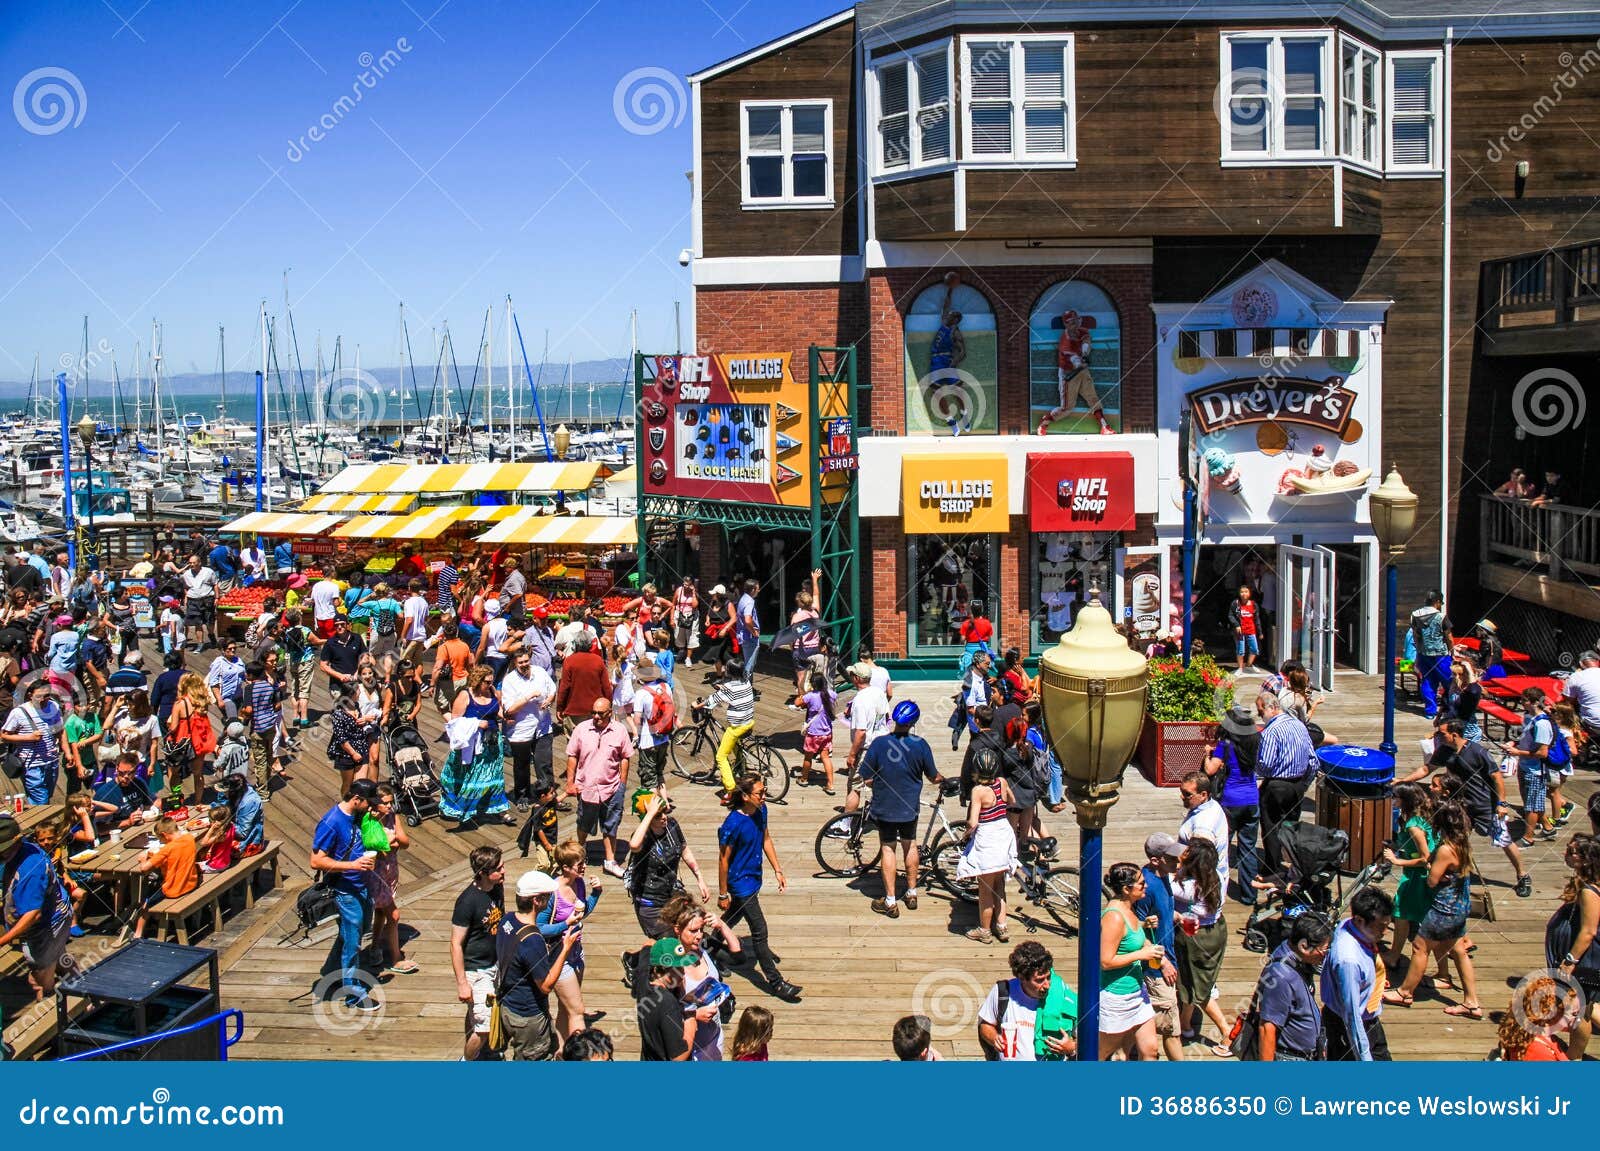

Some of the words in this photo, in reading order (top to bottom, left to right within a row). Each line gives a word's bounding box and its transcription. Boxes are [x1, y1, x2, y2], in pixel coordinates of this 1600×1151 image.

[680, 357, 712, 382] NFL
[729, 358, 783, 380] COLLEGE
[680, 383, 710, 403] Shop
[1201, 384, 1344, 425] Dreyer's
[829, 457, 855, 470] SHOP
[920, 479, 993, 499] COLLEGE
[1075, 478, 1109, 496] NFL
[940, 500, 974, 513] SHOP
[1072, 496, 1107, 514] Shop
